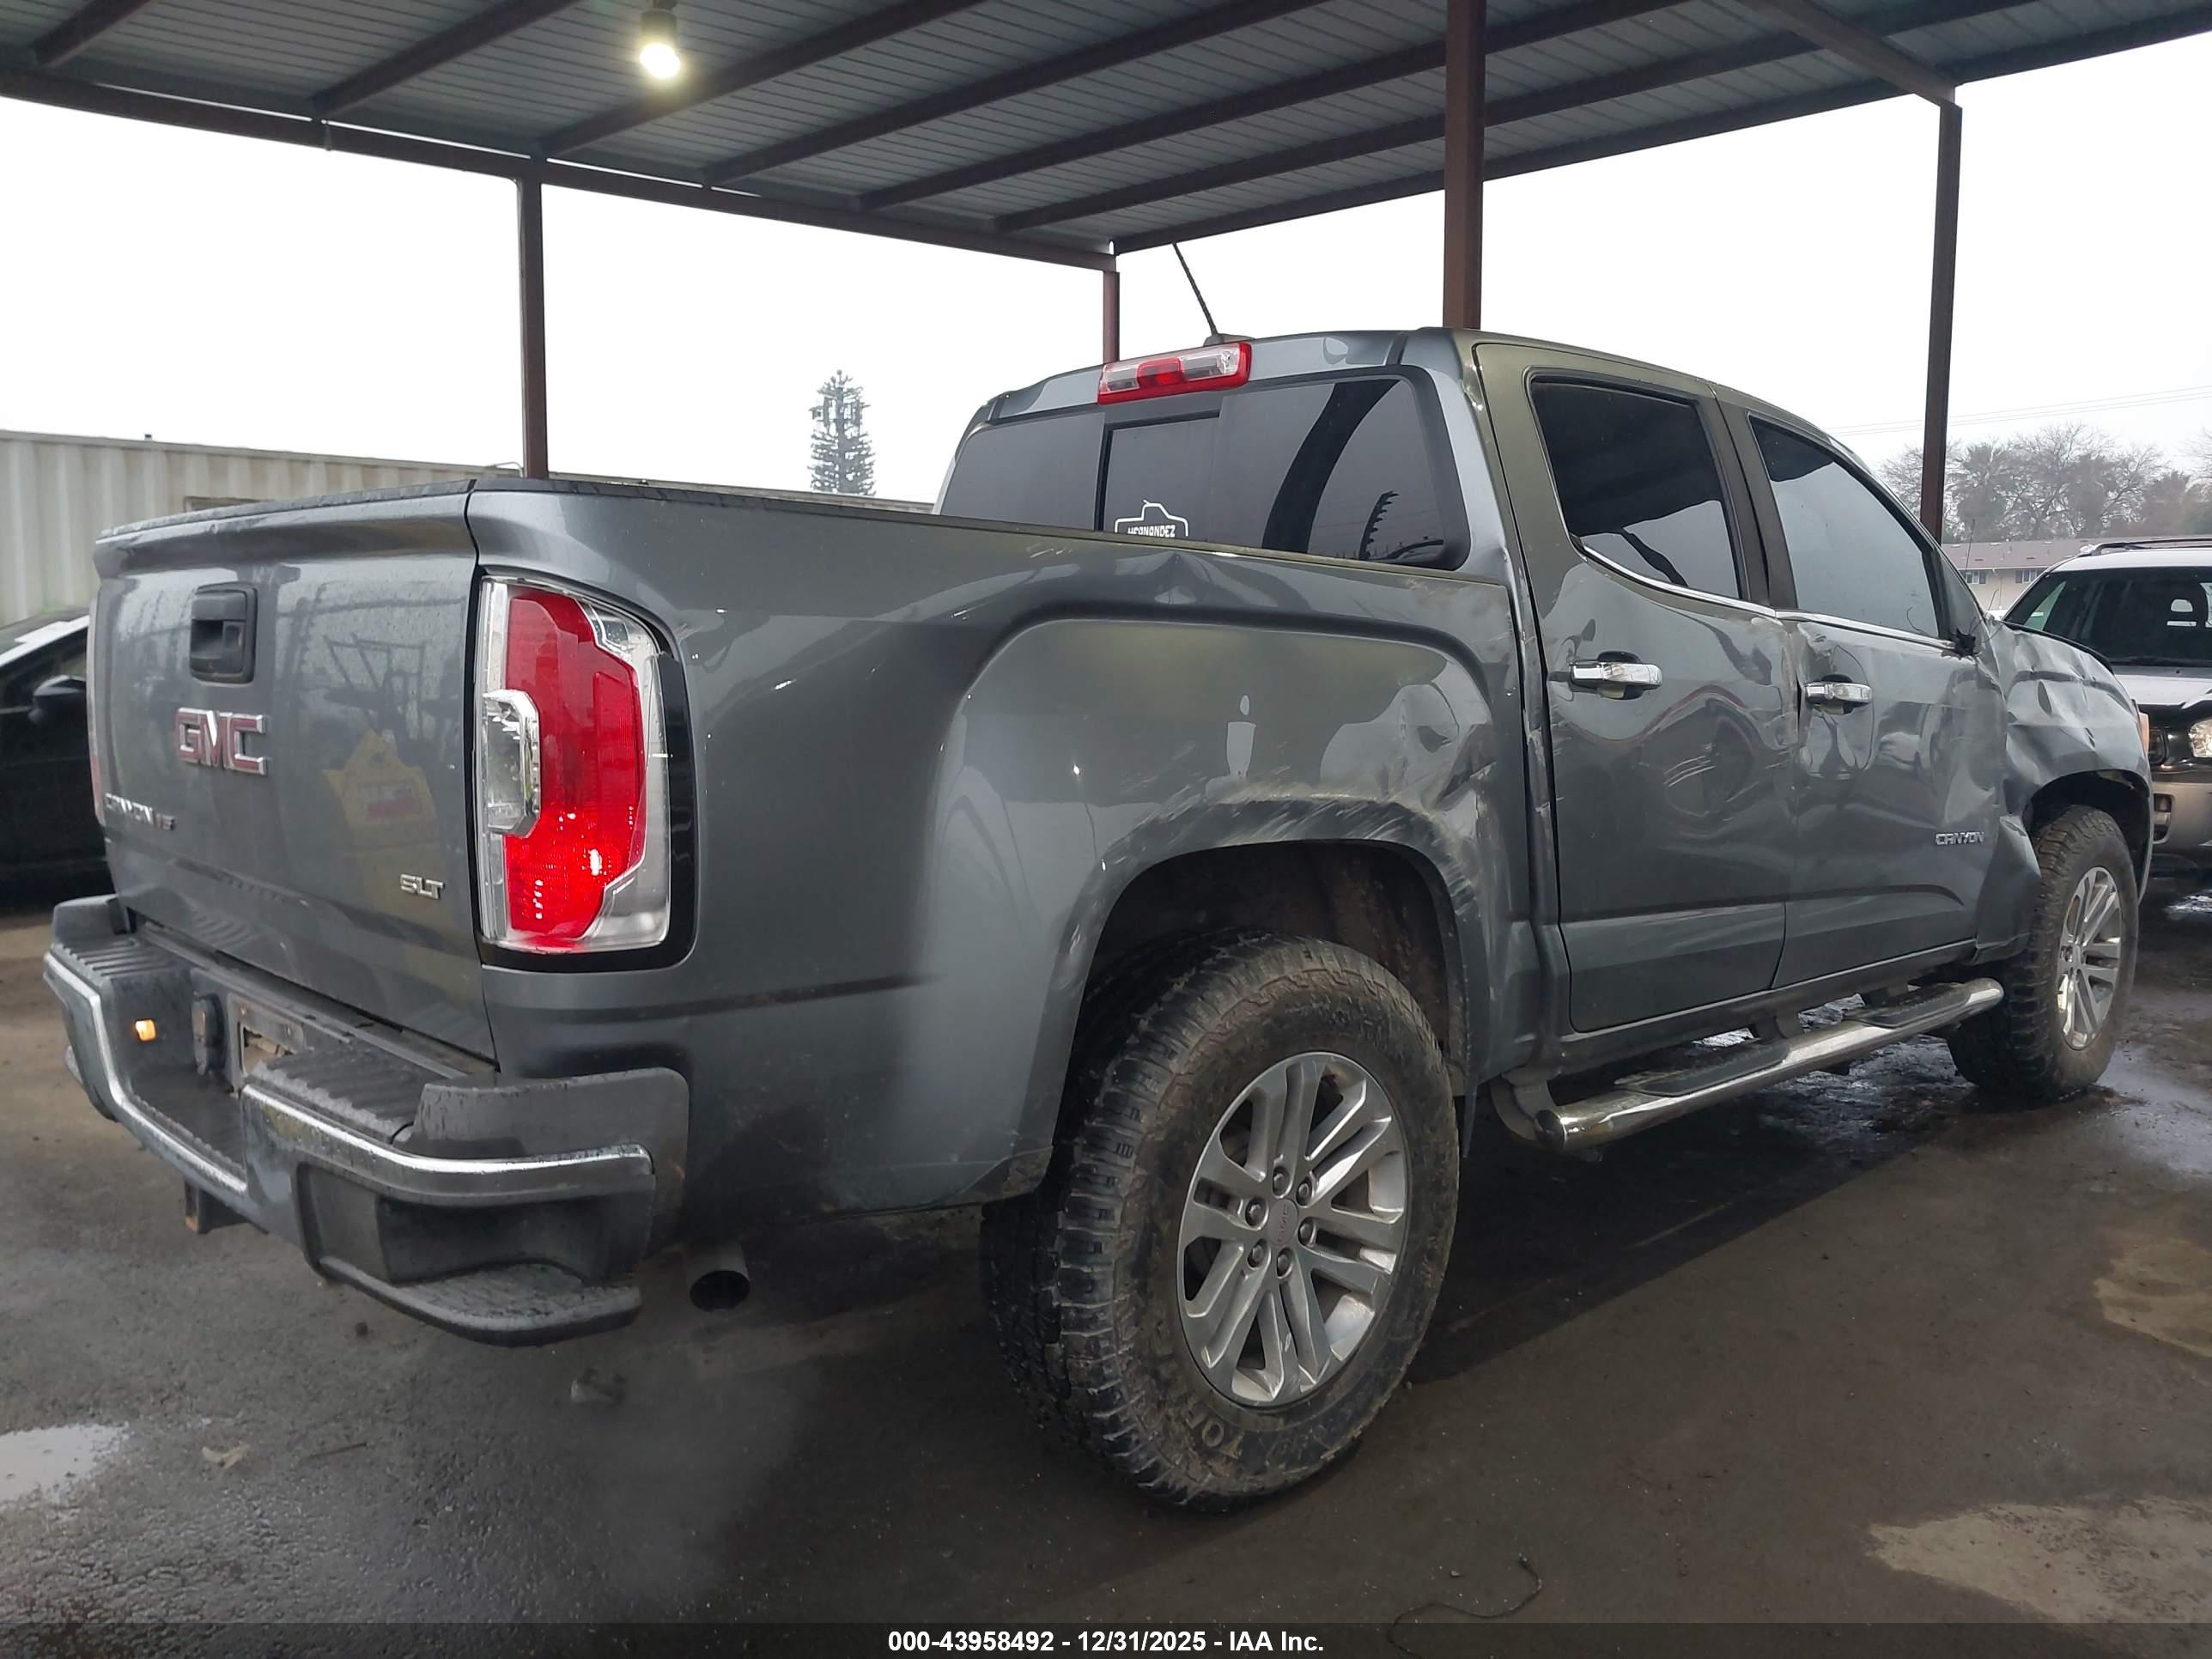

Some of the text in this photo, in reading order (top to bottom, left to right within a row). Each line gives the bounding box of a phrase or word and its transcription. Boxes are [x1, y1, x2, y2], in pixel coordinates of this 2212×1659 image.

[175, 707, 265, 775] GMC
[1936, 831, 1984, 845] CANYON
[400, 873, 444, 899] SLT
